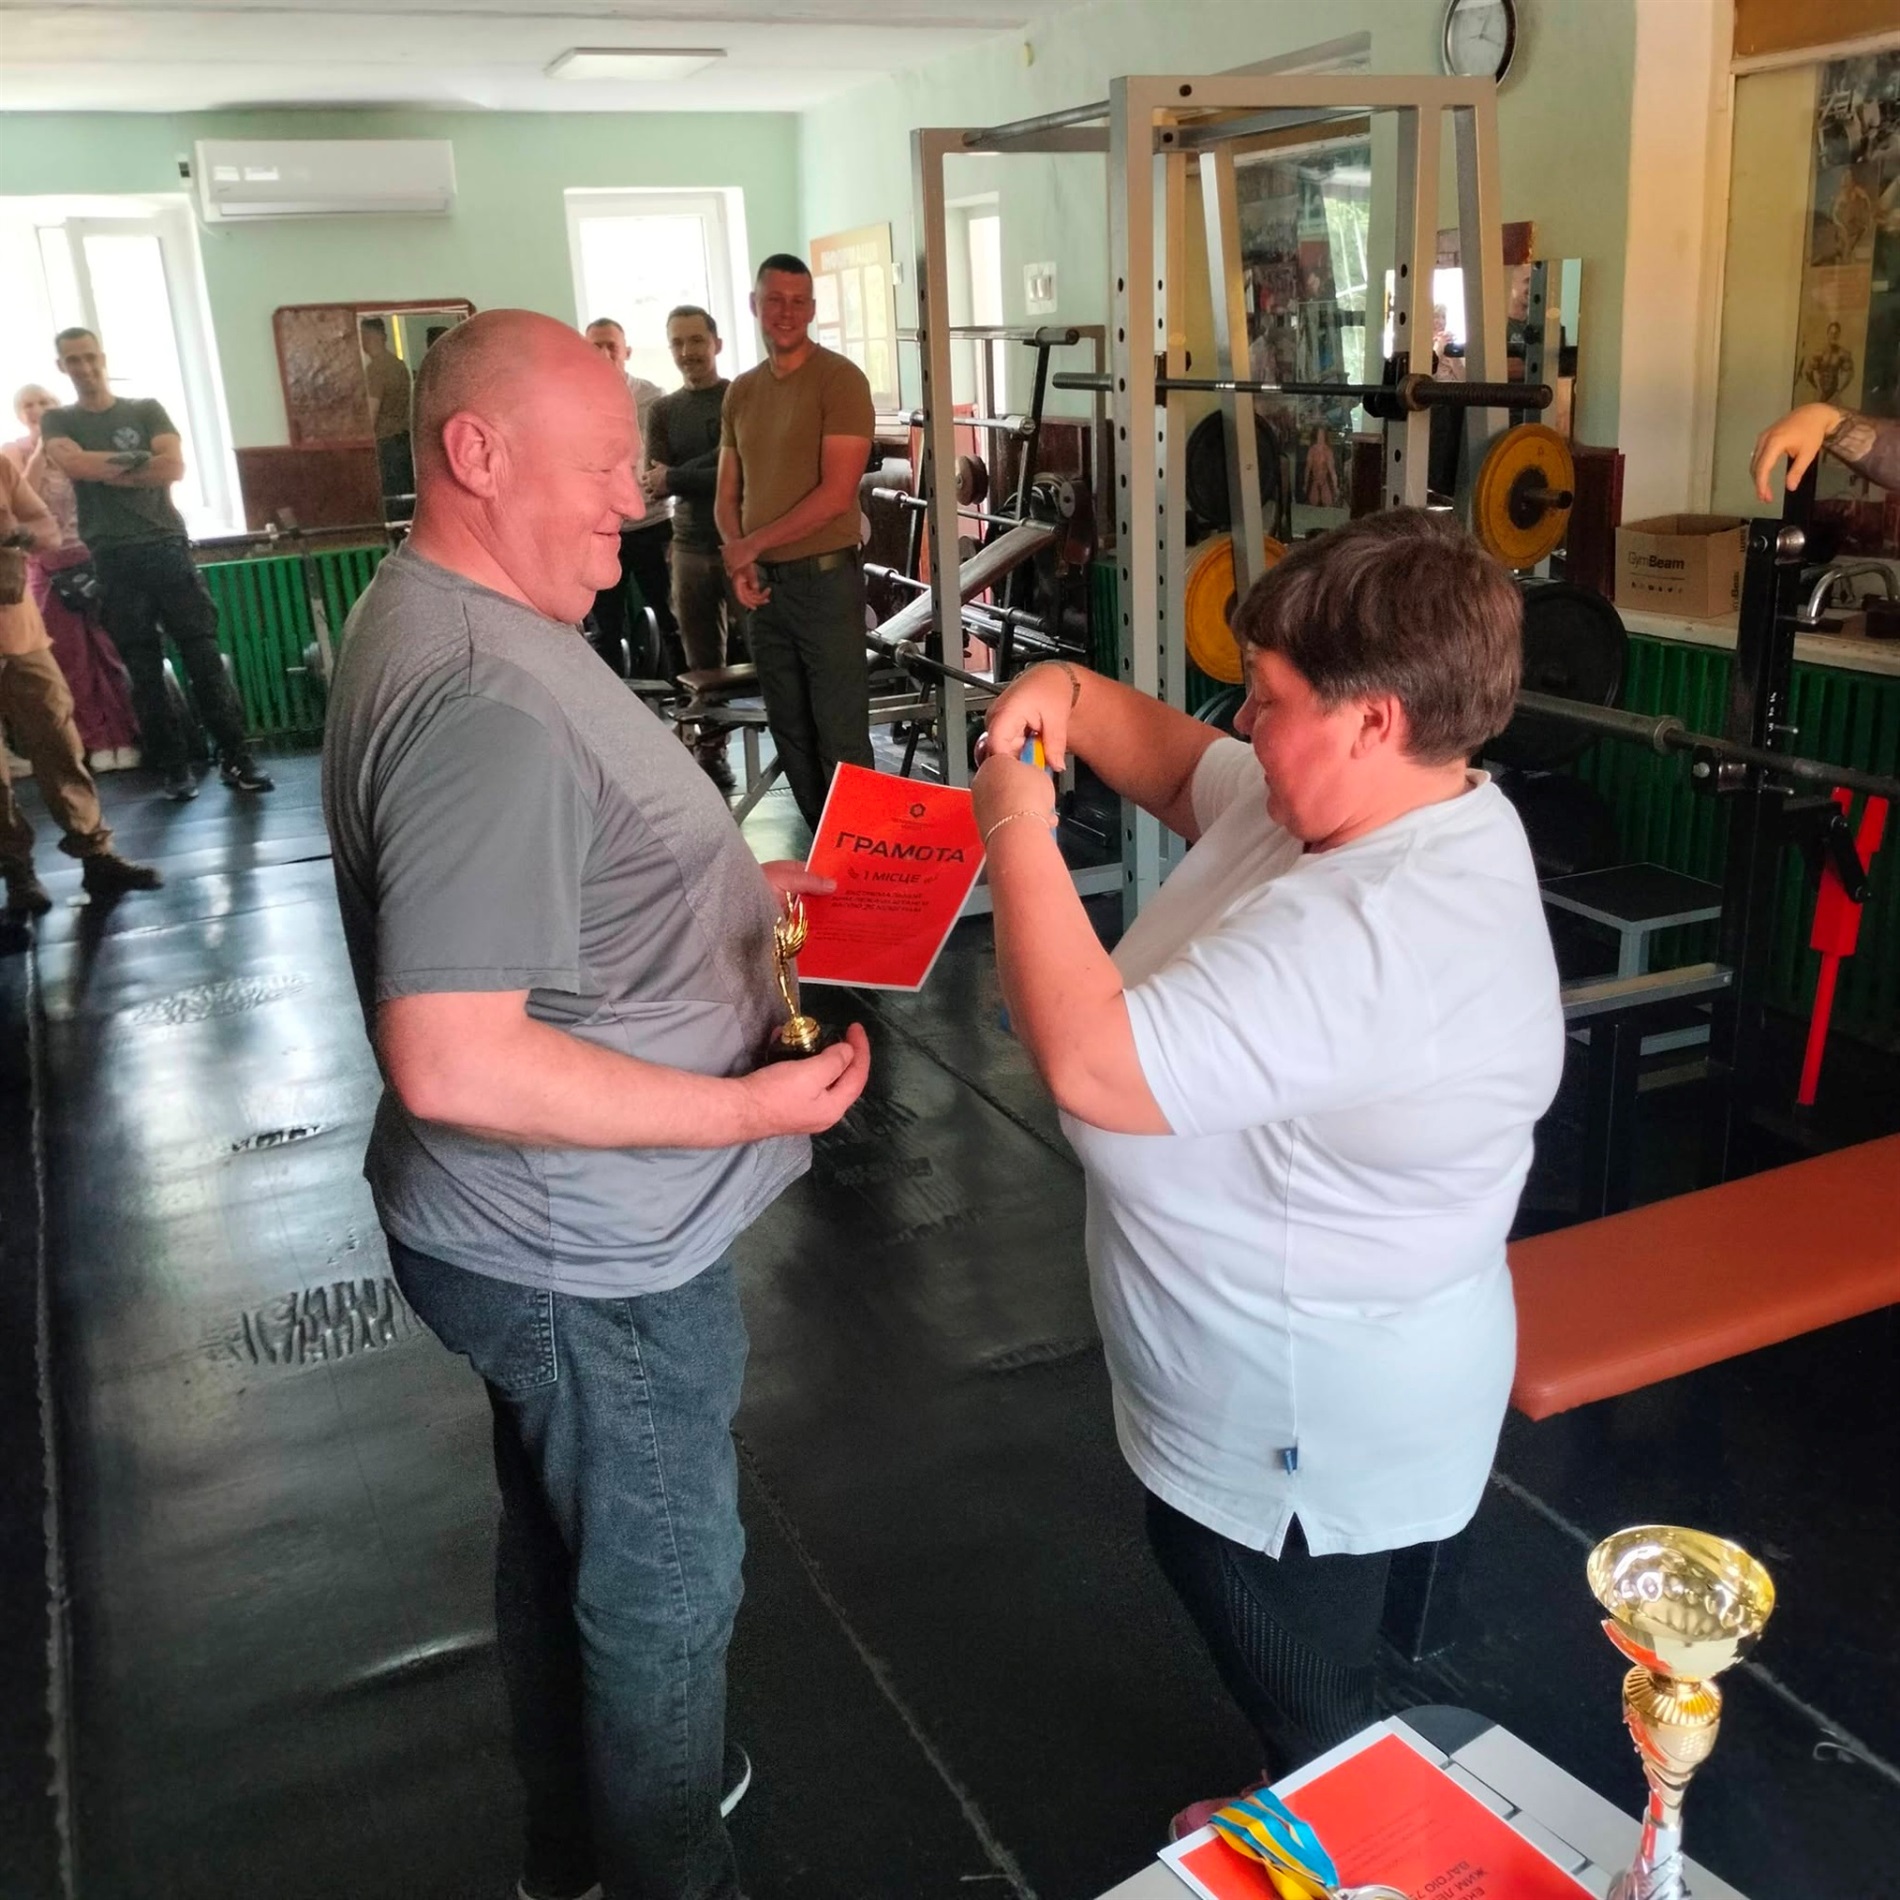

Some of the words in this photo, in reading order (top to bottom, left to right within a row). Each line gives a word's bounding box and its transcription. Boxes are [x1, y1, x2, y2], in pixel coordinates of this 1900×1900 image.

[1628, 551, 1685, 570] GymBeam
[835, 831, 965, 863] ГРАМОТА
[872, 871, 922, 884] МІСЦЕ
[1424, 1860, 1470, 1893] ВАГОЮ
[1454, 1867, 1487, 1891] ЖИМ
